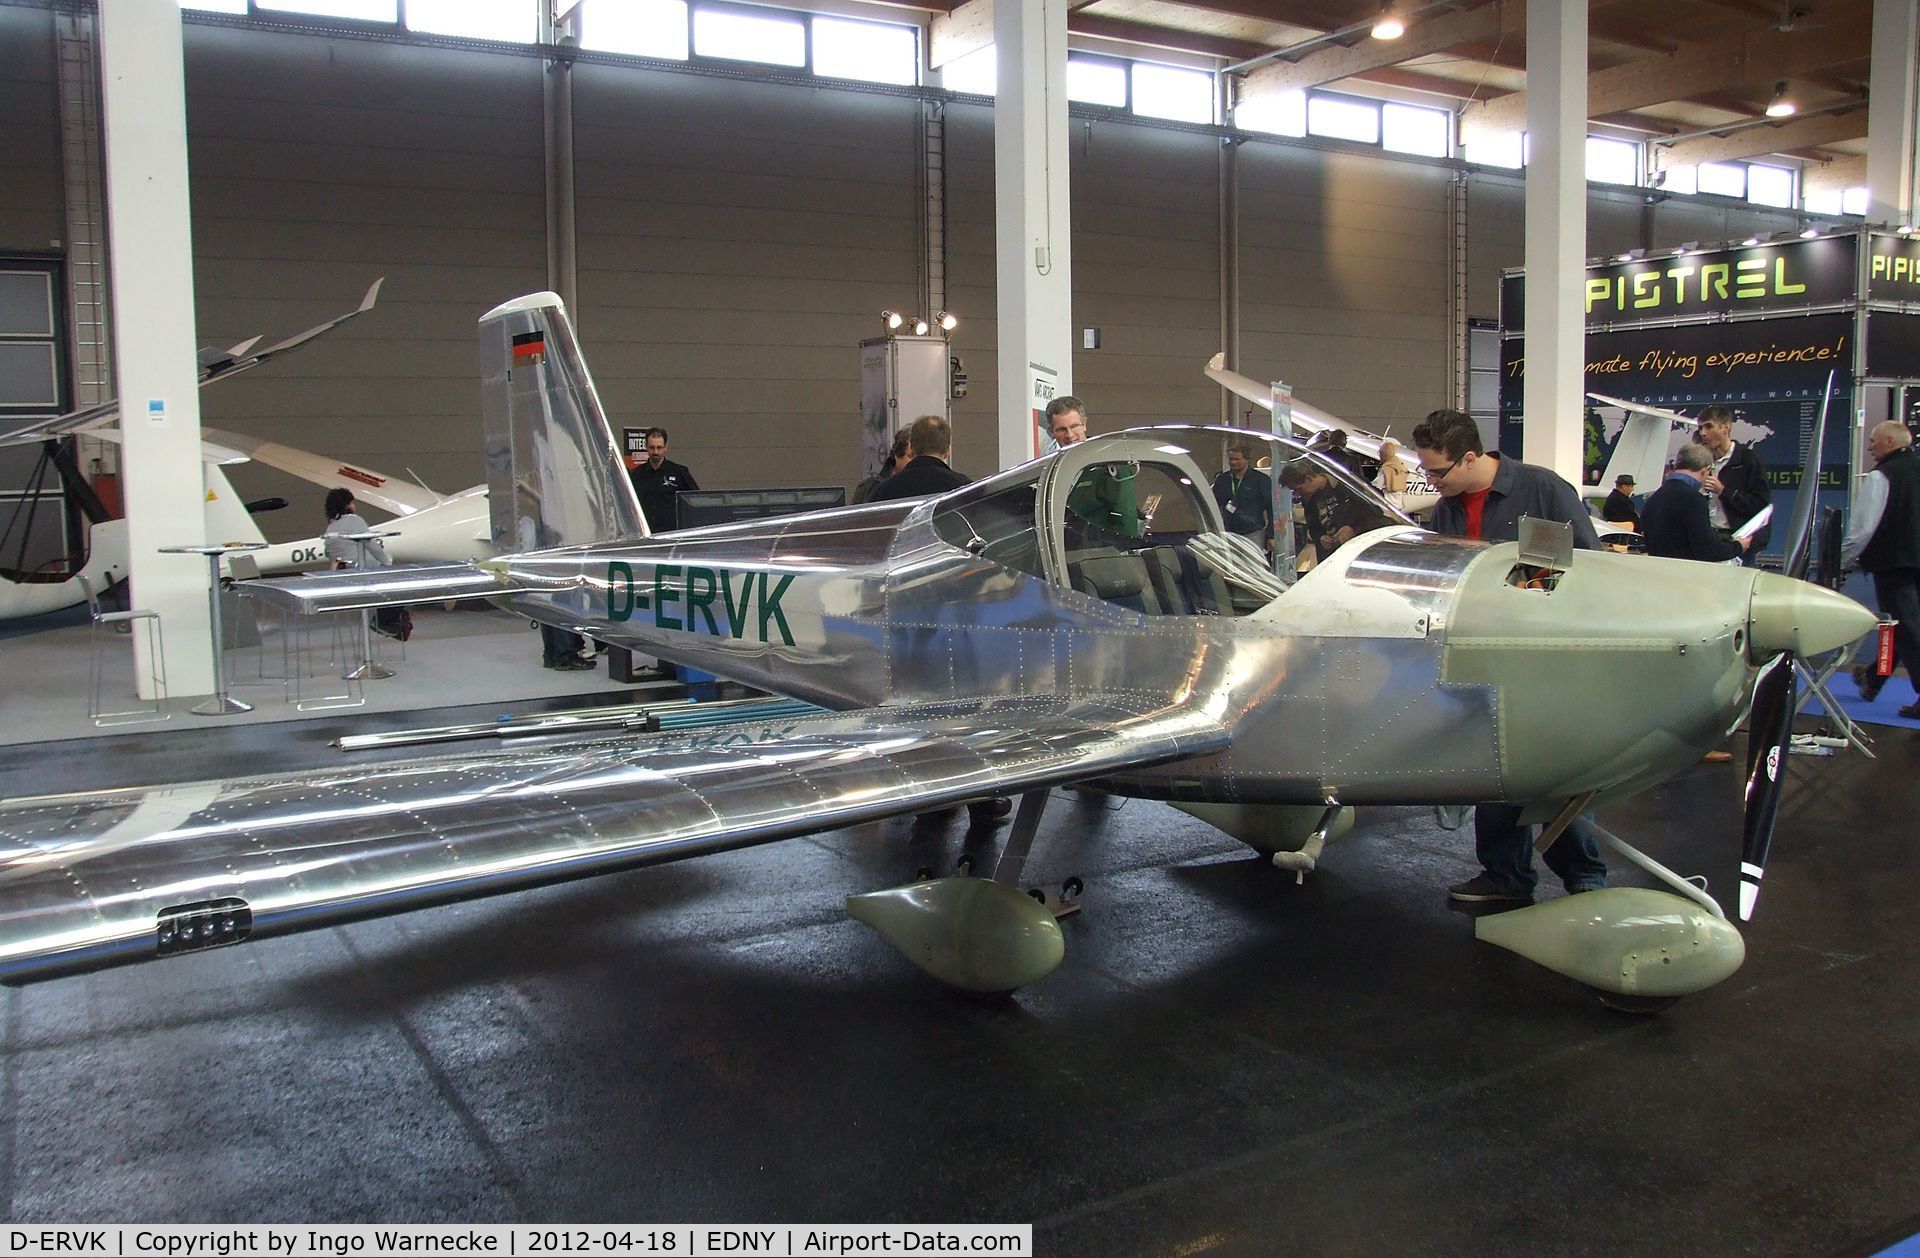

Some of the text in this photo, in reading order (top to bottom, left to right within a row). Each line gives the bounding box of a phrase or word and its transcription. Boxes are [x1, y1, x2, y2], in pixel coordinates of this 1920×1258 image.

[1585, 257, 1806, 313] PISTREL
[1584, 353, 1631, 375] mate
[1638, 350, 1698, 378] flying
[1705, 336, 1845, 373] experience!
[1619, 394, 1692, 403] ROUND
[1712, 392, 1747, 400] THE
[1769, 388, 1840, 398] WORLD
[608, 561, 796, 647] D-ERVK
